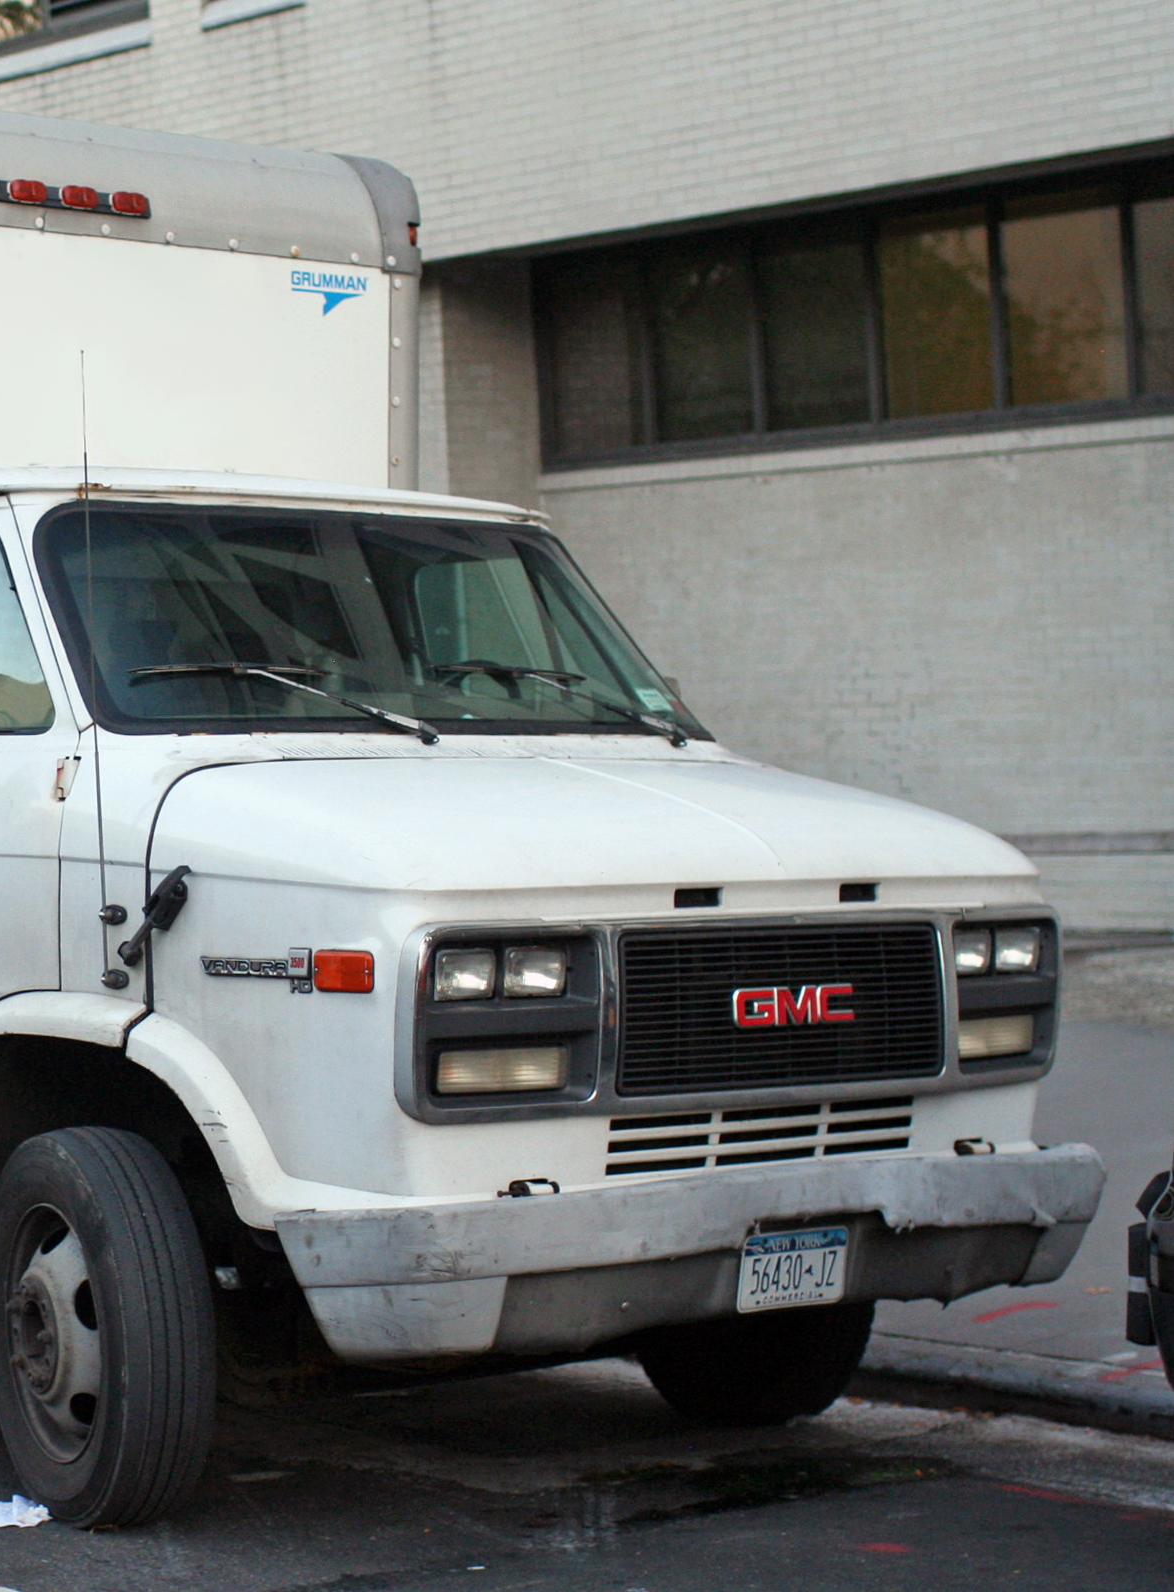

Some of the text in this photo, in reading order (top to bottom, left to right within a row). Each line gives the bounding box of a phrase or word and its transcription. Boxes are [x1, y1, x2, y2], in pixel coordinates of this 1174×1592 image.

[291, 270, 367, 291] GRUMMAN
[200, 955, 288, 977] VANDURA
[290, 979, 313, 994] HD
[732, 982, 855, 1028] GMC
[768, 1234, 822, 1252] NEW YORK
[750, 1251, 837, 1295] 56430 JZ
